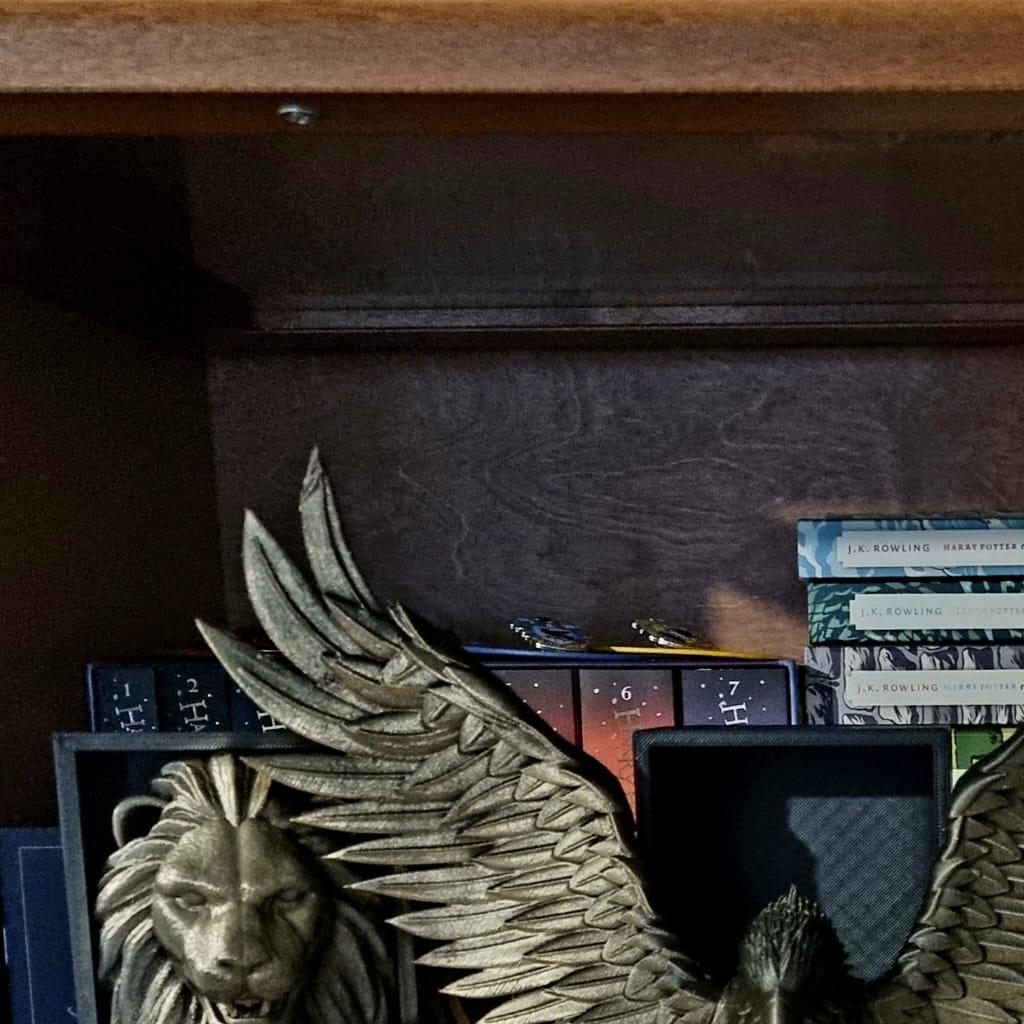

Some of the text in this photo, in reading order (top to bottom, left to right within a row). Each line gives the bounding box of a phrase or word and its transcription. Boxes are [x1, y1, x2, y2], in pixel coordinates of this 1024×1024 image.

[873, 543, 930, 553] ROWLING
[943, 543, 977, 551] HARRY
[979, 543, 1017, 551] POTTER
[886, 607, 943, 616] ROWLING
[124, 683, 130, 697] 1
[186, 678, 199, 693] 2
[728, 681, 740, 696] 7
[883, 683, 938, 692] ROWLING
[620, 685, 632, 701] 6
